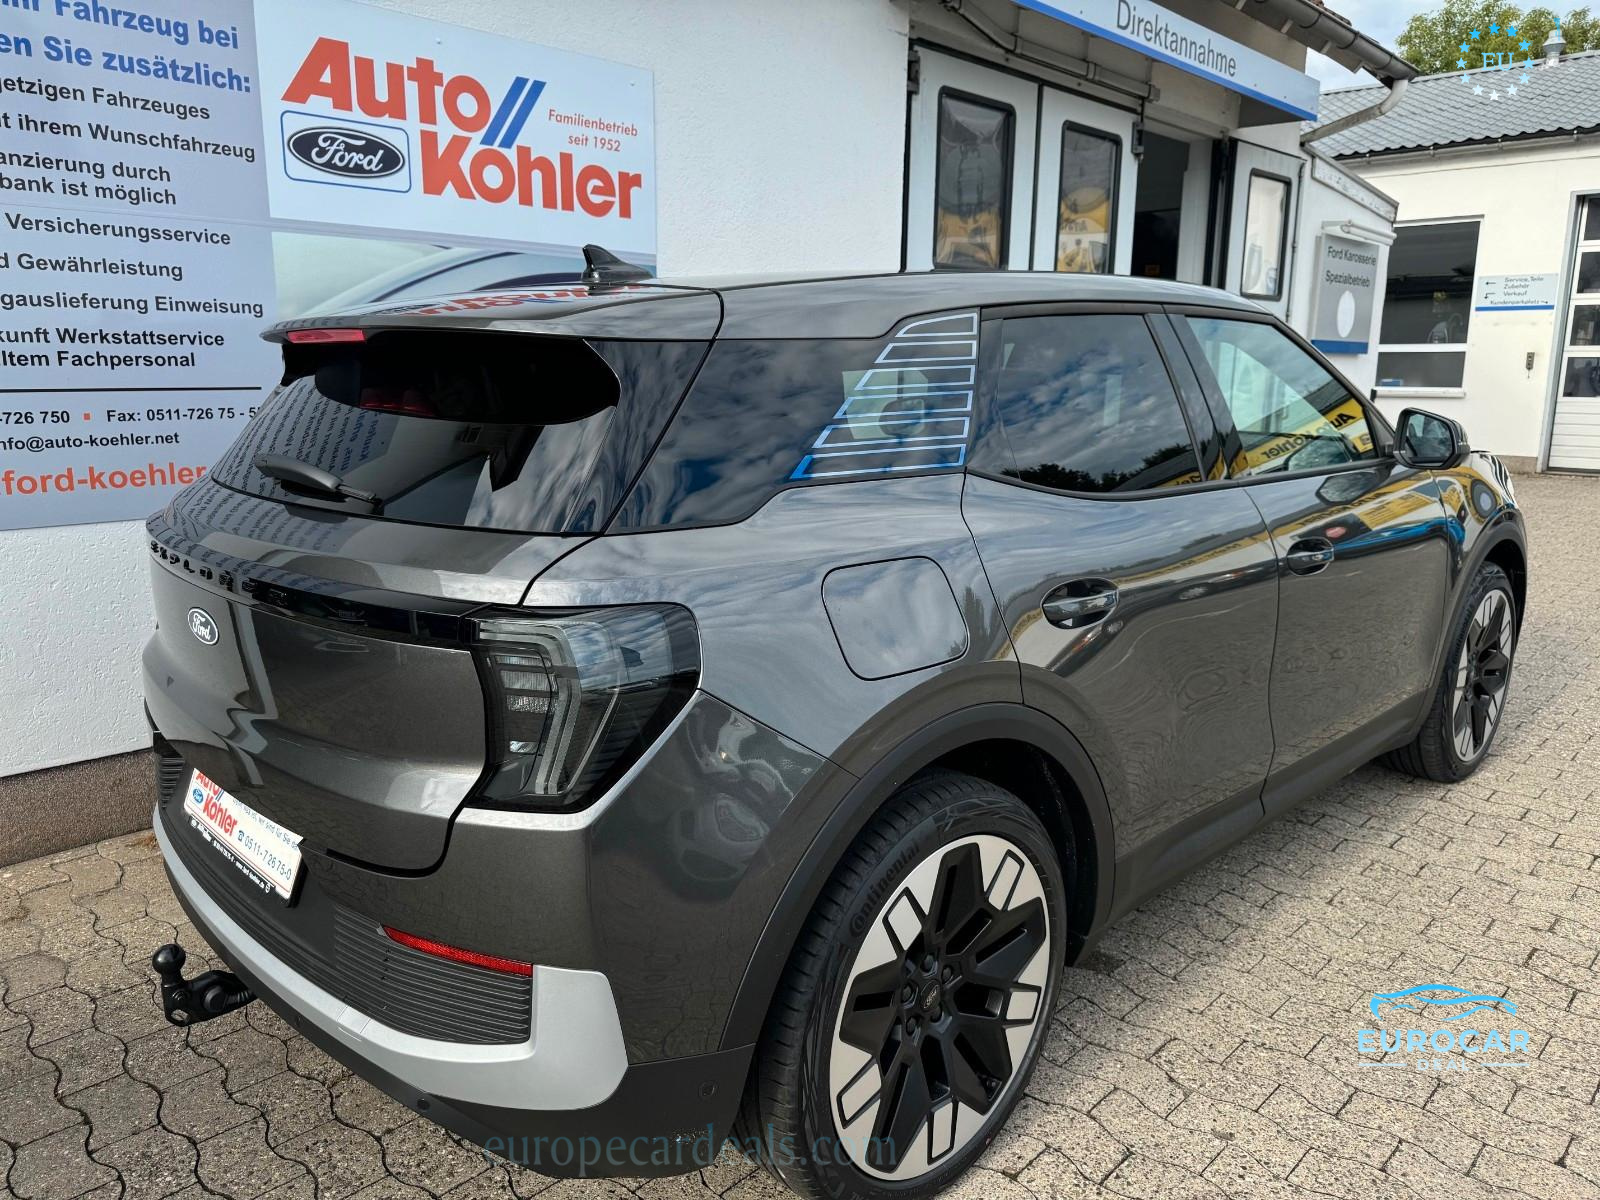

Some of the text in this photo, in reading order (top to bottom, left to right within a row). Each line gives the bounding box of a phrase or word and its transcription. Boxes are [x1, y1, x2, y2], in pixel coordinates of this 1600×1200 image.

[54, 0, 239, 49] Fahrzeug bei
[1116, 0, 1237, 77] Direktannahme
[43, 35, 92, 66] Sie
[102, 51, 251, 93] zusätzlich:
[280, 36, 492, 133] Auto
[92, 86, 210, 120] Fahrzeuges
[18, 113, 82, 138] ihrem
[88, 122, 256, 162] Wunschfahrzeug
[548, 109, 639, 137] Familienbetrieb
[310, 134, 384, 174] Ford
[568, 134, 622, 152] seit 1952
[0, 151, 171, 182] anzierung durch
[0, 172, 177, 205] bank ist möglich
[5, 212, 231, 245] Versicherungsservice
[17, 253, 183, 281] Gewährleistung
[1328, 245, 1377, 266] Ford Karosserie
[1325, 270, 1370, 288] Spezialbetrieb
[0, 291, 264, 318] gauslieferung Einweisung
[56, 327, 225, 346] Werkstattservice
[0, 350, 196, 370] ltem Fachpersonal
[39, 410, 70, 424] 750
[106, 409, 141, 422] Fax:
[146, 408, 214, 421] 0511-726
[217, 407, 235, 419] 75
[248, 406, 260, 419] 5
[0, 432, 180, 453] nfo@auto-koehler.net
[0, 462, 207, 496] ford-koehler
[191, 612, 212, 641] Ford
